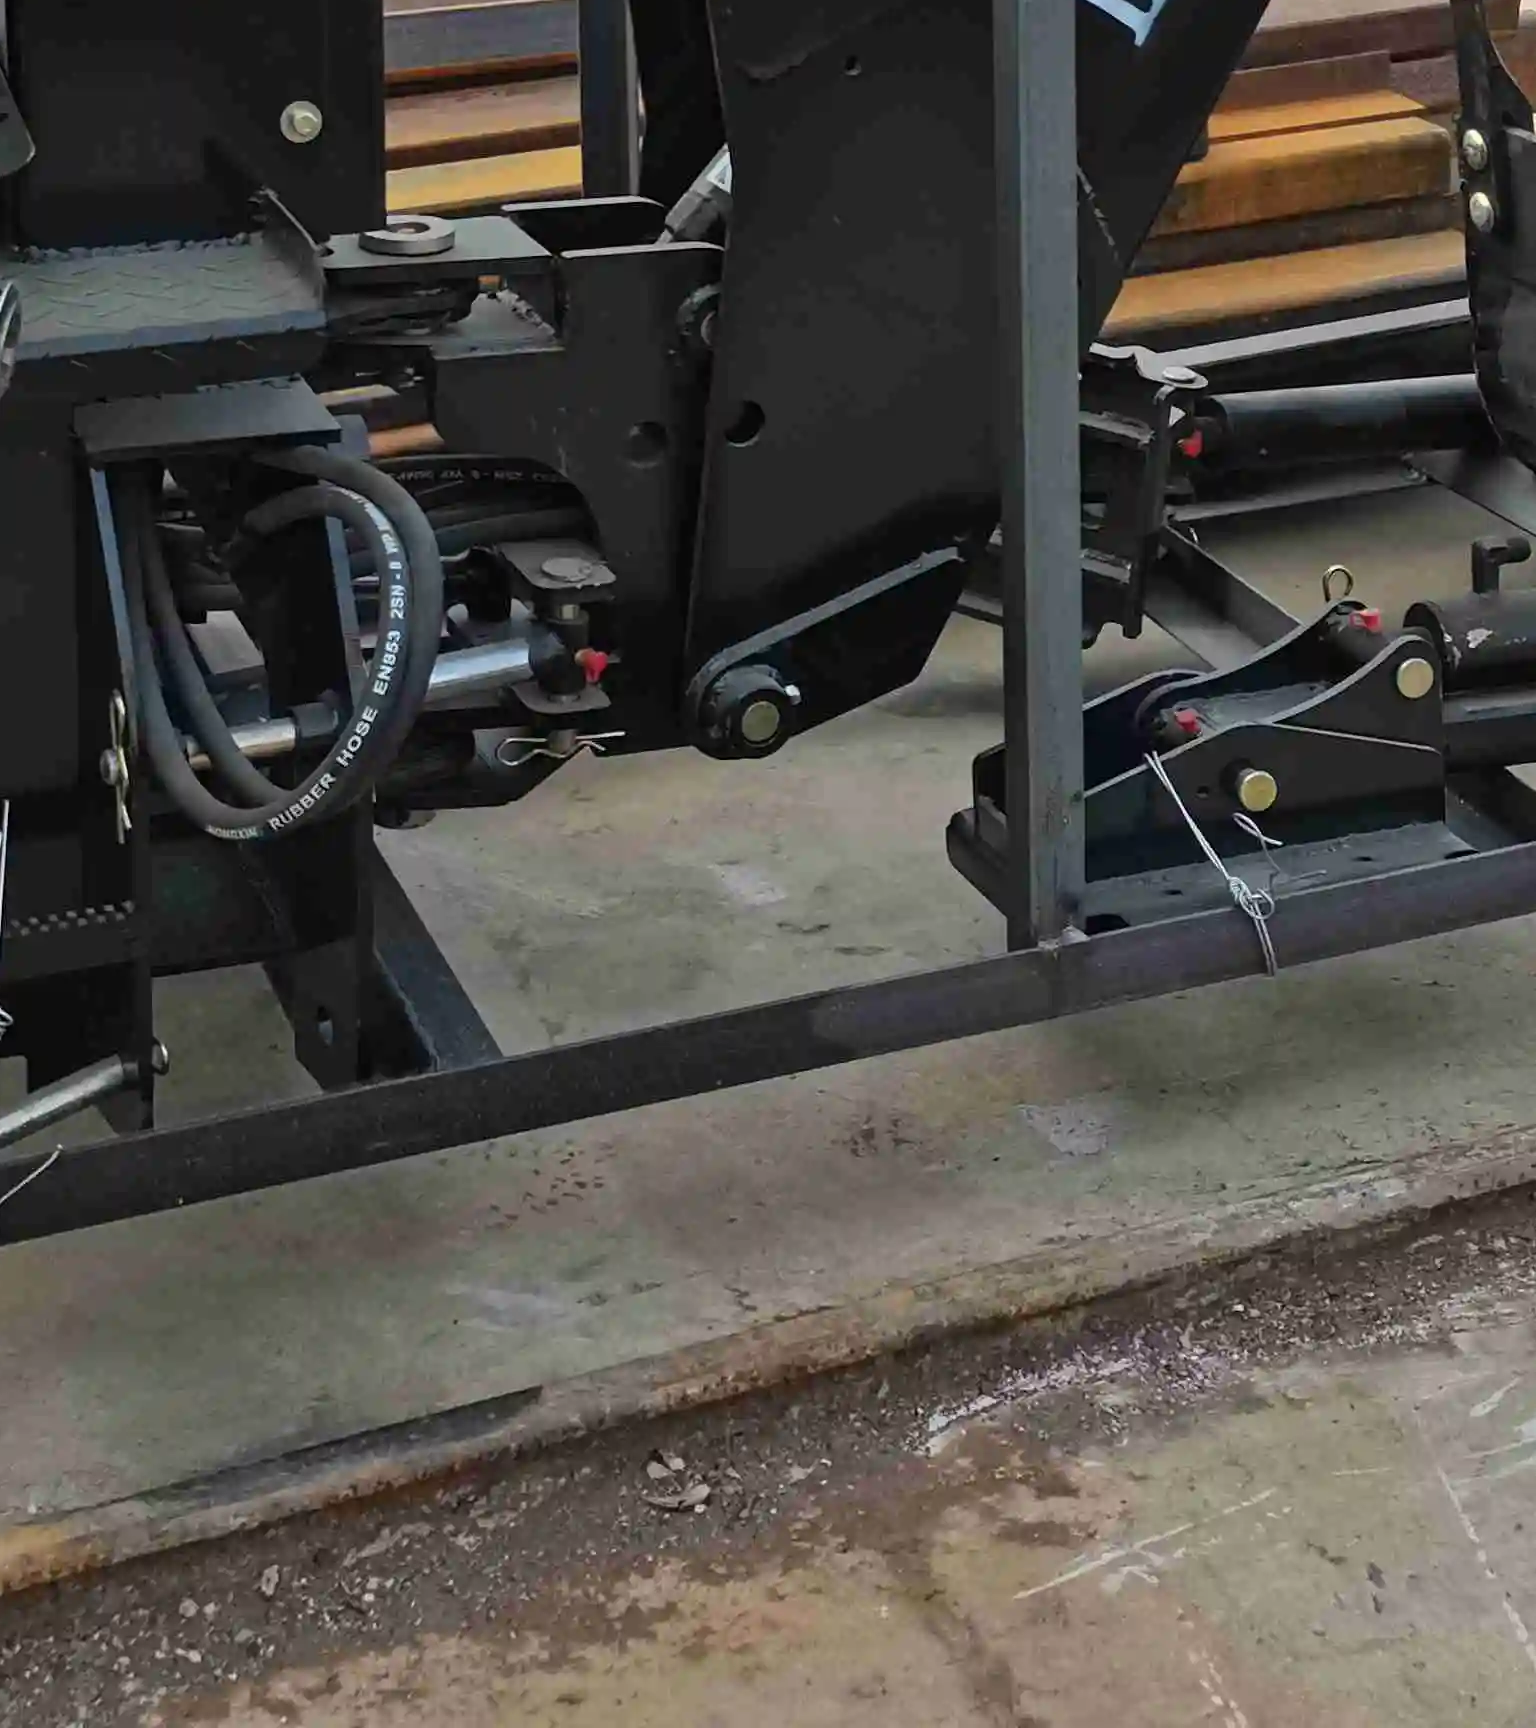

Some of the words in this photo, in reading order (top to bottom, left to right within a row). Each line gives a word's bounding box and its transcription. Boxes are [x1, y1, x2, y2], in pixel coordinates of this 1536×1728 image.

[267, 772, 337, 832] RUBBER
[336, 707, 379, 768] HOSE
[390, 583, 406, 619] 2SN
